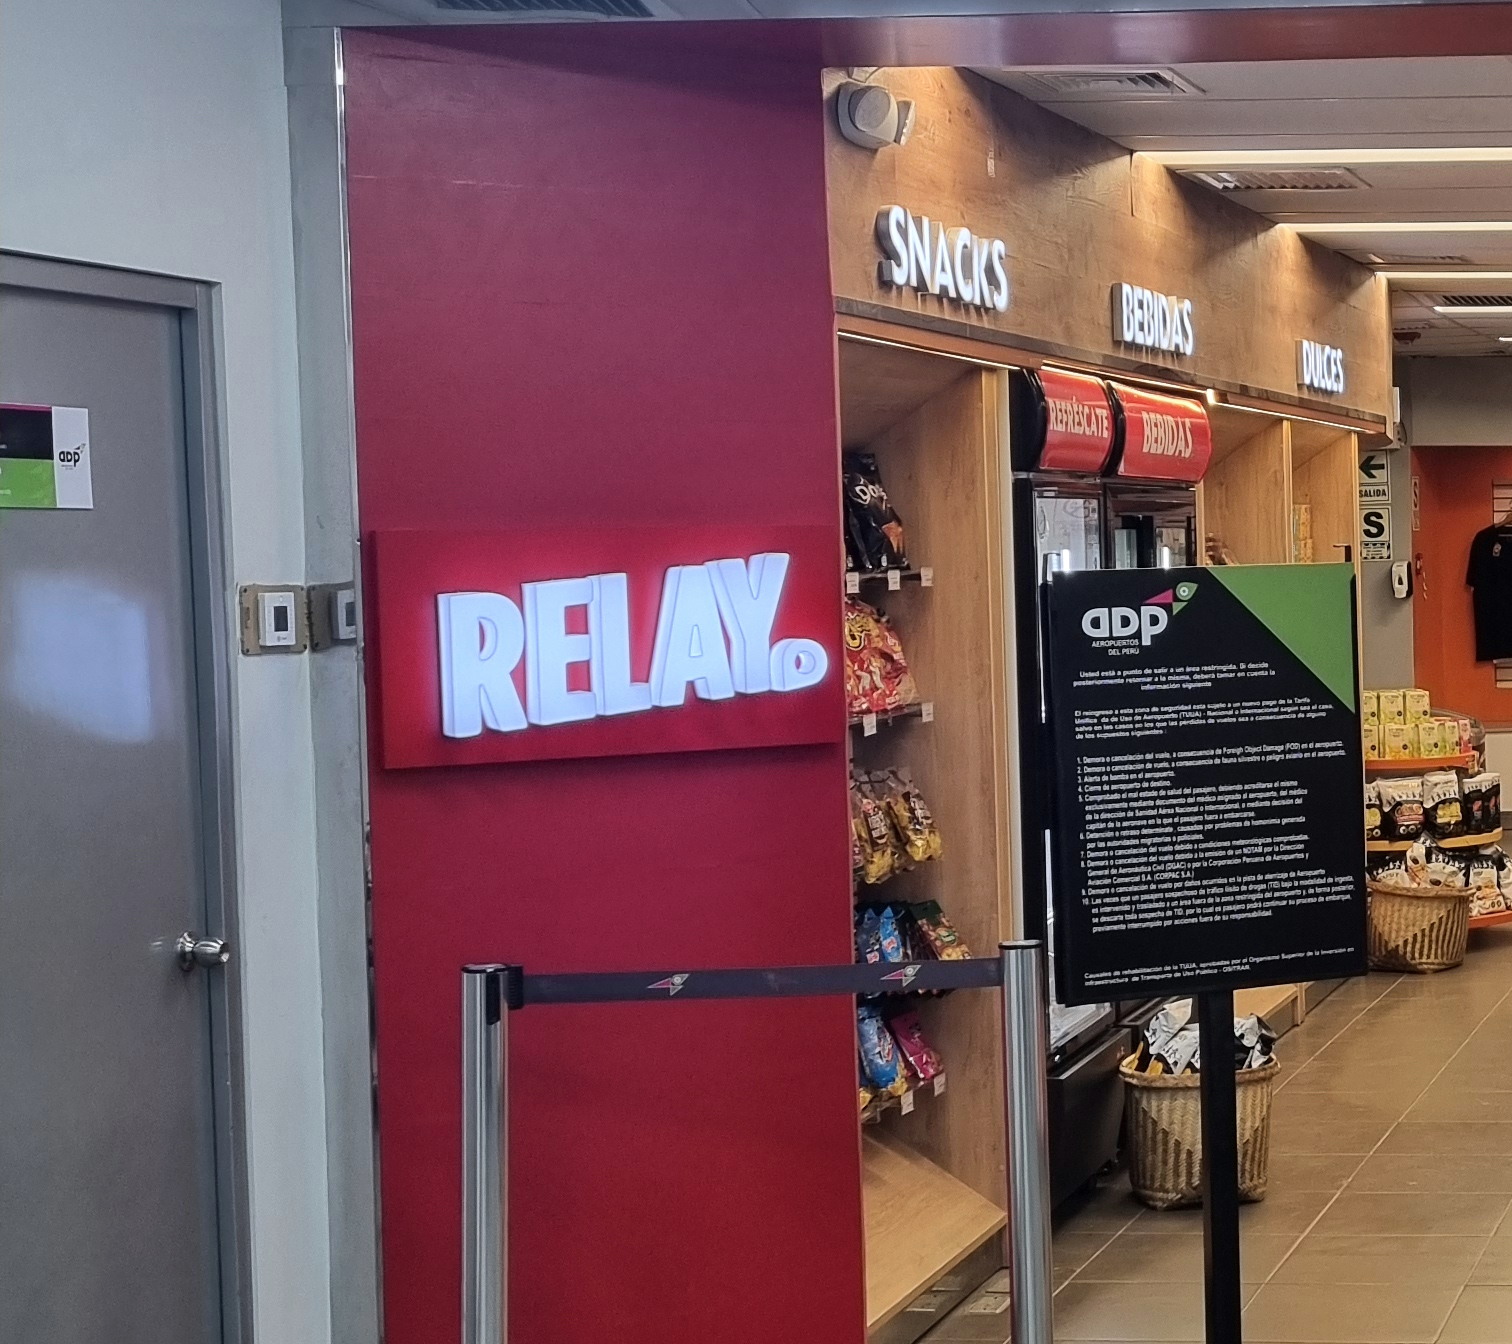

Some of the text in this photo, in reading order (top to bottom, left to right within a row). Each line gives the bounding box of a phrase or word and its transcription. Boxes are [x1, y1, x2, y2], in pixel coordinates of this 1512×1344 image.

[878, 205, 1009, 312] SNACKS
[1114, 283, 1194, 355] BEBIDAS
[1298, 339, 1345, 393] DULCES
[1049, 396, 1109, 438] REFRÉSCATE
[1142, 411, 1192, 458] BEBIDAS
[1359, 488, 1387, 498] SALIDA
[1363, 511, 1385, 538] S
[1091, 638, 1140, 647] AEROPUERTOS
[1108, 648, 1121, 656] DEL
